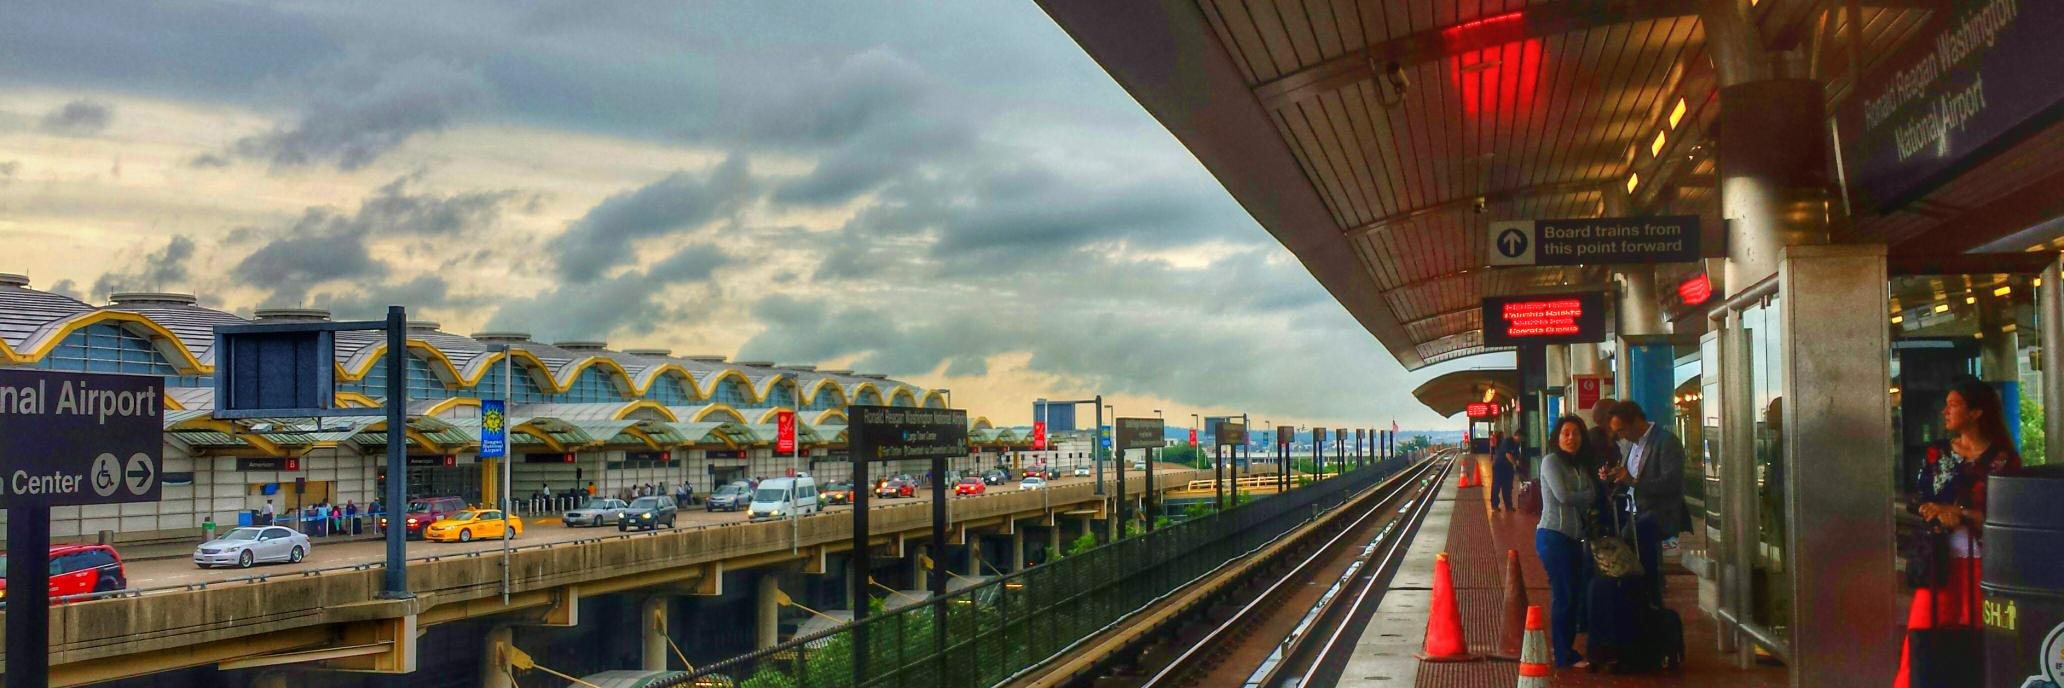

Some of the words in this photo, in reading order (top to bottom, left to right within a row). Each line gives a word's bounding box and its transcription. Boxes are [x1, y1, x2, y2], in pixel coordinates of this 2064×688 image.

[1864, 77, 1896, 132] Ronald
[1896, 52, 1938, 101] Reagan
[1936, 0, 2017, 72] Washington
[1895, 101, 1940, 162] National
[1940, 71, 1986, 133] Airport
[1544, 225, 1591, 239] Board
[1595, 224, 1640, 238] trains
[1644, 223, 1681, 236] from
[1544, 242, 1572, 255] this
[1577, 241, 1617, 257] point
[1621, 239, 1682, 253] forward
[55, 380, 156, 425] Airport
[12, 469, 82, 495] Center
